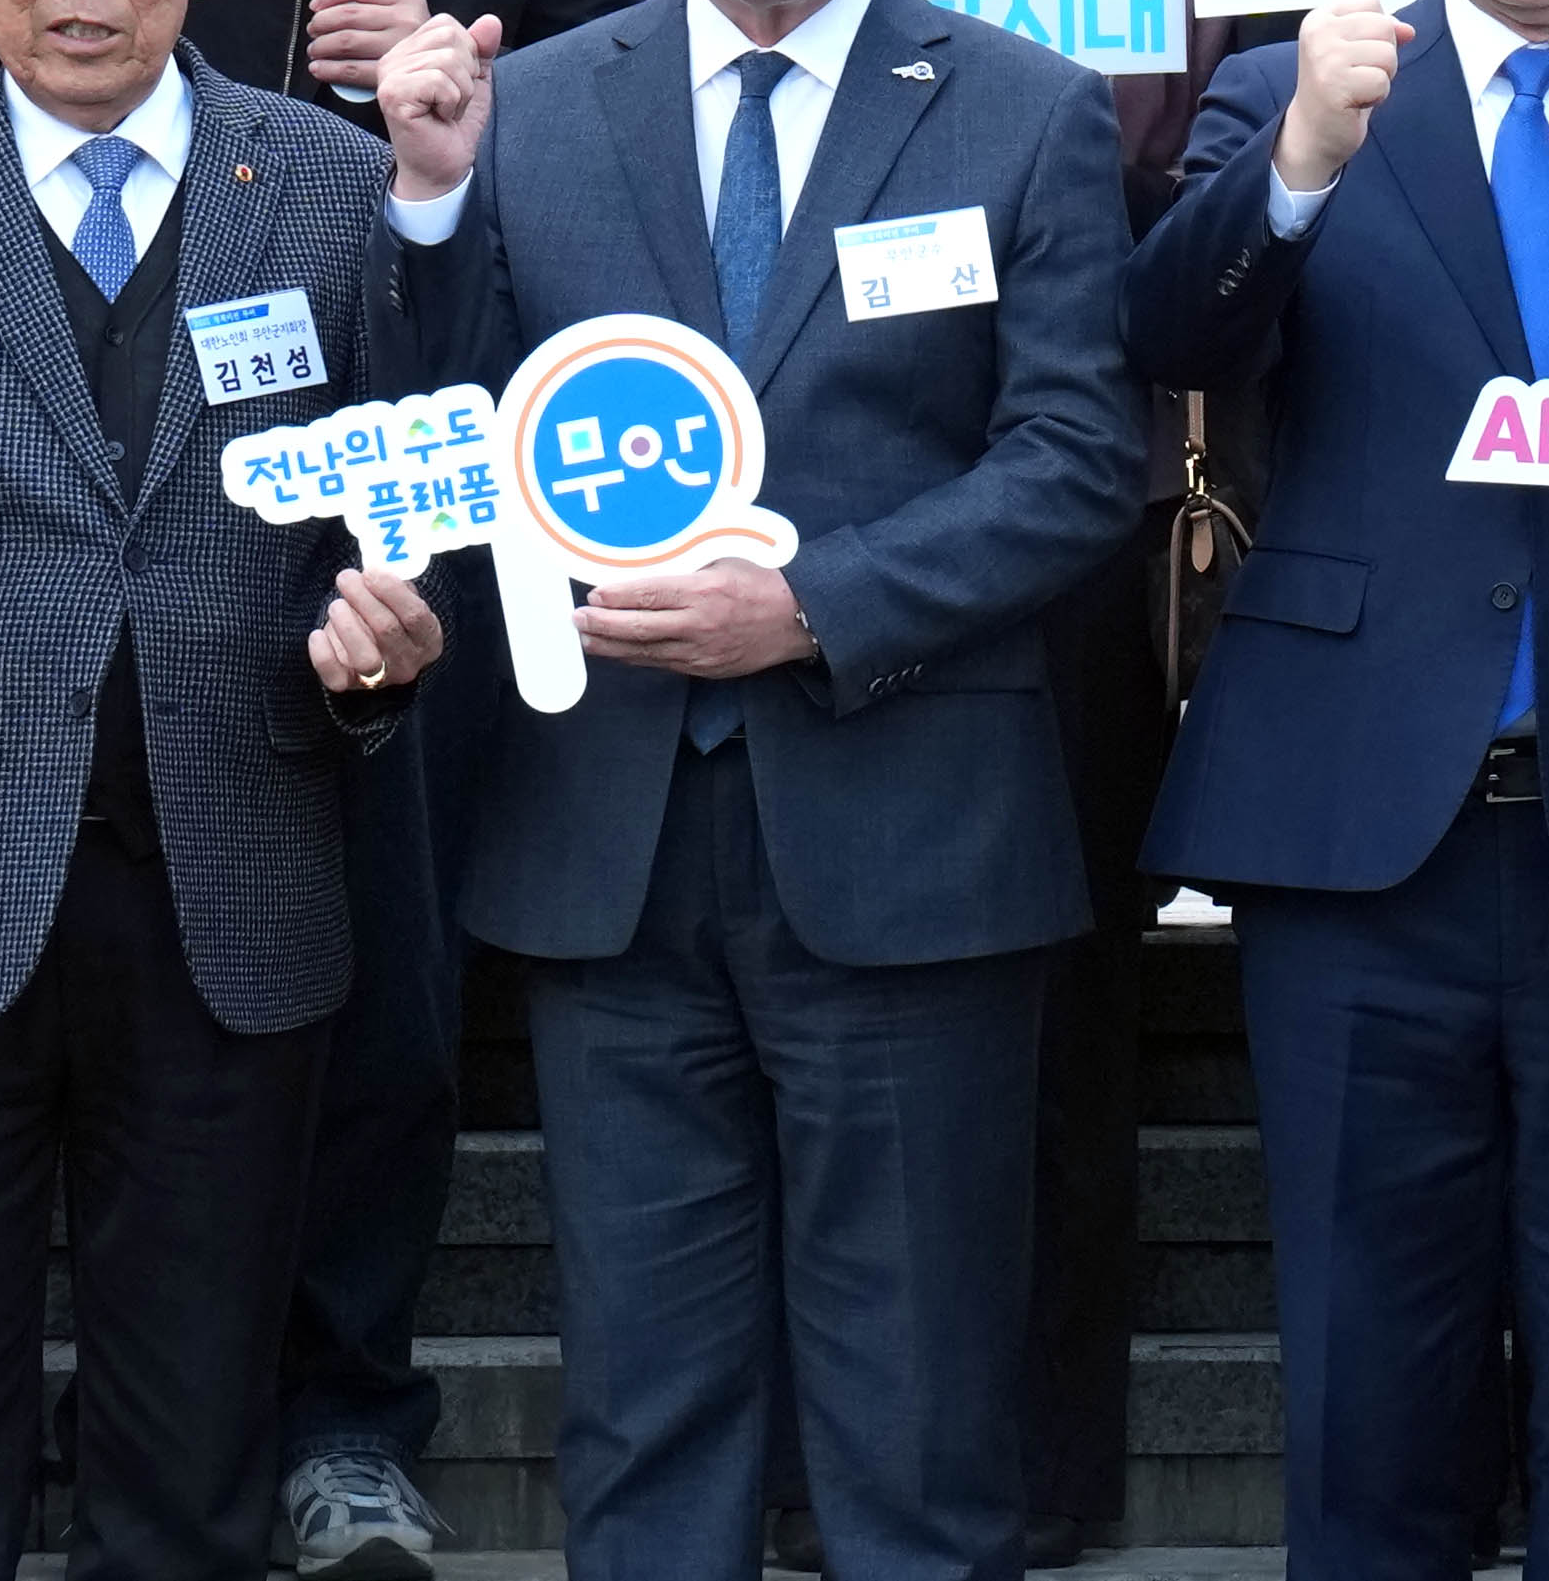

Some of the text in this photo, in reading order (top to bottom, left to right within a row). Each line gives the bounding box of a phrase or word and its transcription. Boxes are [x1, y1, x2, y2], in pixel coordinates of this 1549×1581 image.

[245, 408, 486, 503] 전남의 수도
[553, 414, 712, 513] 무안
